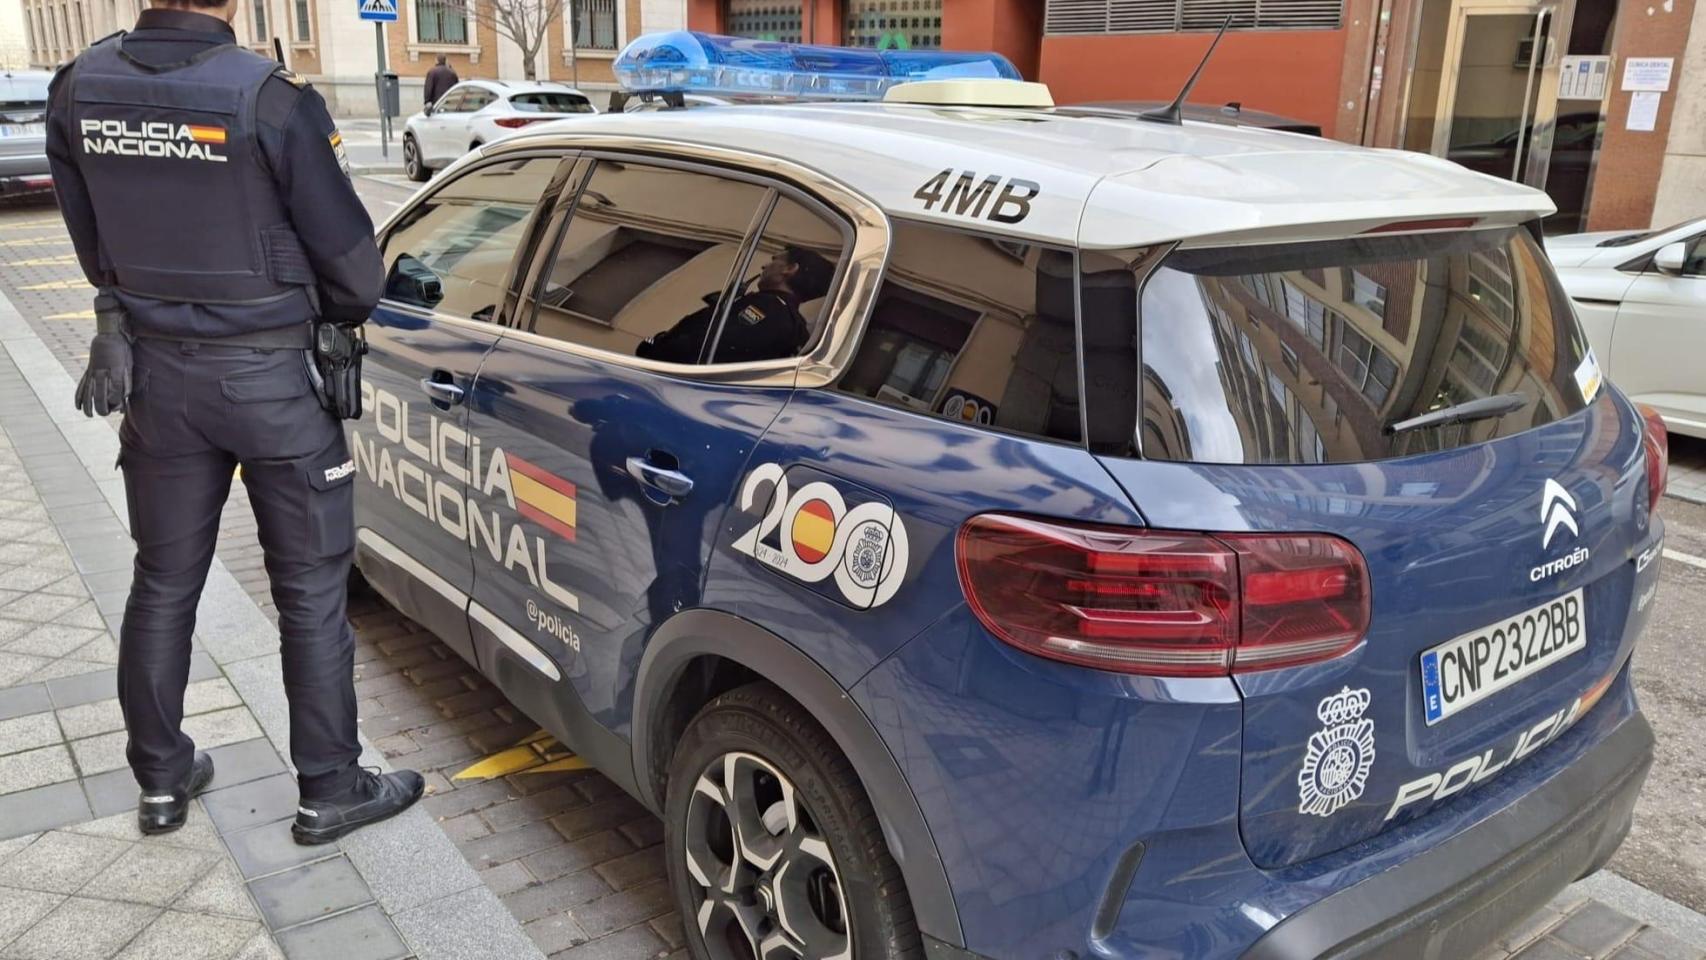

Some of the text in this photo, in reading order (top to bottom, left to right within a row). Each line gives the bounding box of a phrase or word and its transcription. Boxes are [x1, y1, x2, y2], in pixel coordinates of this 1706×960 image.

[80, 119, 195, 141] POLICIA
[83, 137, 228, 162] NACIONAL
[913, 168, 1040, 224] 4MB
[352, 430, 579, 613] NACIONAL
[731, 462, 909, 608] 200
[526, 599, 580, 653] @policia
[1441, 595, 1580, 703] CNP2322BB
[1430, 694, 1438, 711] E
[1384, 698, 1581, 821] POLICIA
